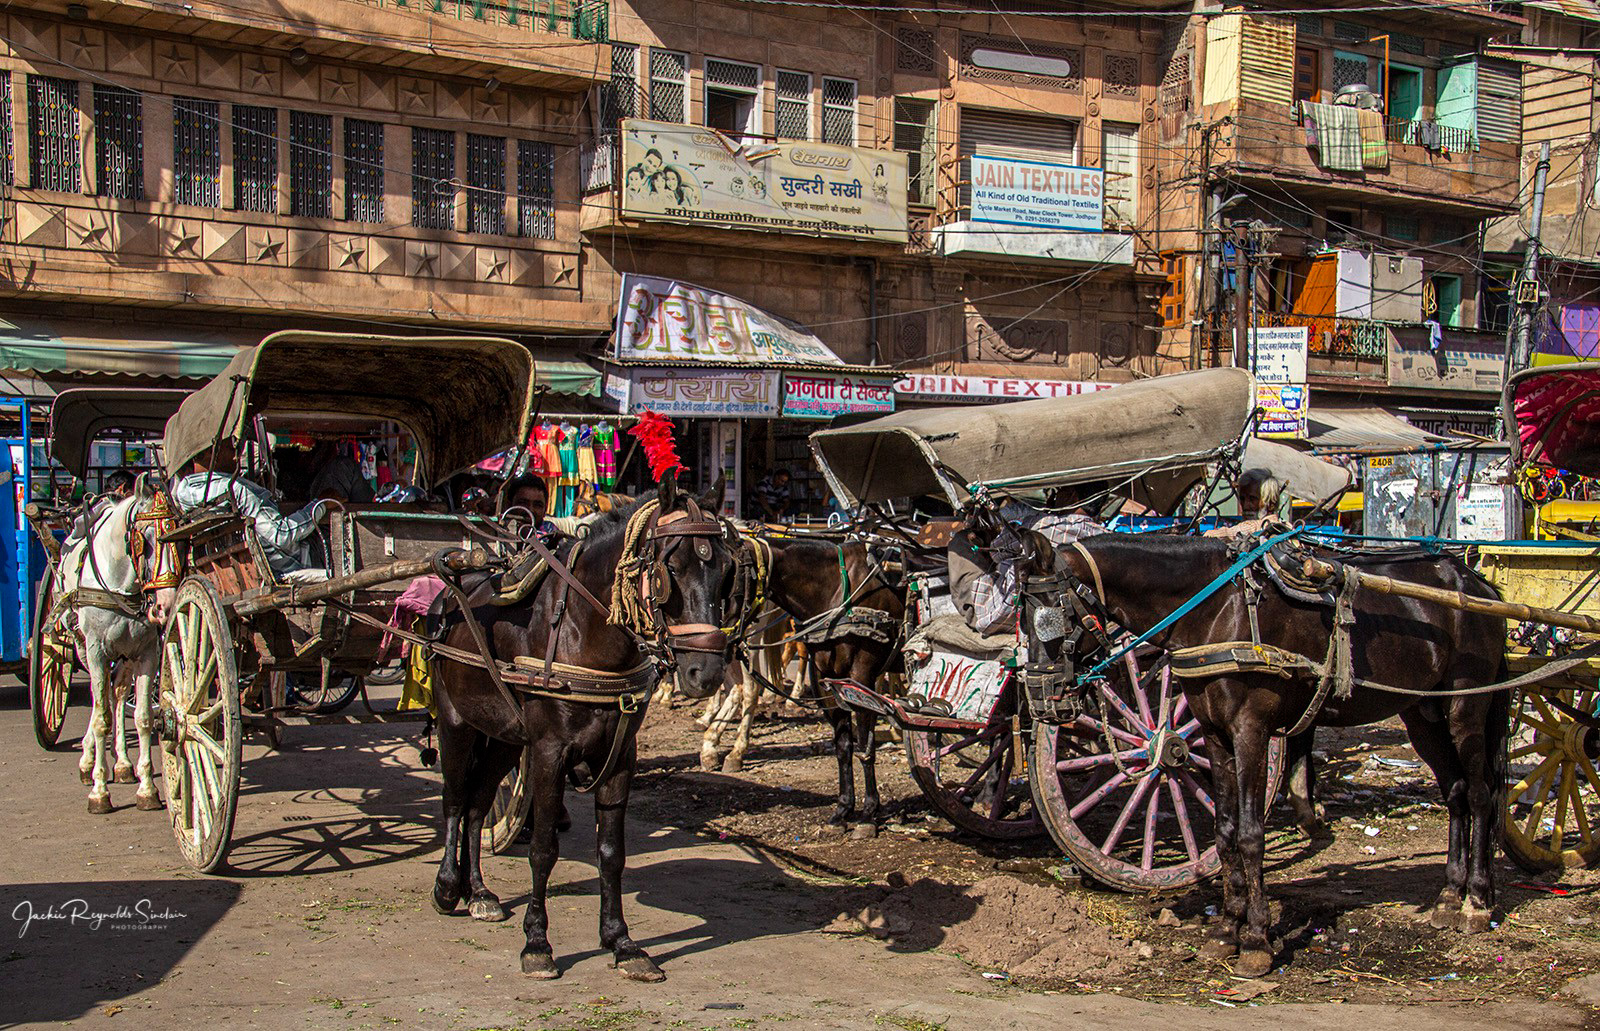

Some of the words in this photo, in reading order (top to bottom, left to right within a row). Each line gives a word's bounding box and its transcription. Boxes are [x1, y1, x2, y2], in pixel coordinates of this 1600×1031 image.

[792, 149, 852, 169] बैद्यनाथ
[780, 174, 825, 197] सुन्दरी
[829, 178, 862, 199] सखी
[975, 163, 1015, 189] JAIN
[1020, 167, 1101, 198] TEXTILES
[976, 190, 987, 199] All
[988, 191, 1006, 200] Kind
[1007, 193, 1015, 202] of
[1016, 194, 1030, 203] Old
[1031, 195, 1070, 207] Traditional
[1072, 199, 1100, 210] Textiles
[978, 203, 993, 212] Cycle
[994, 205, 1012, 213] Market
[1075, 213, 1097, 221] Jodhpur
[785, 375, 836, 399] जनता
[840, 377, 853, 400] टी
[900, 377, 969, 394] JAIN
